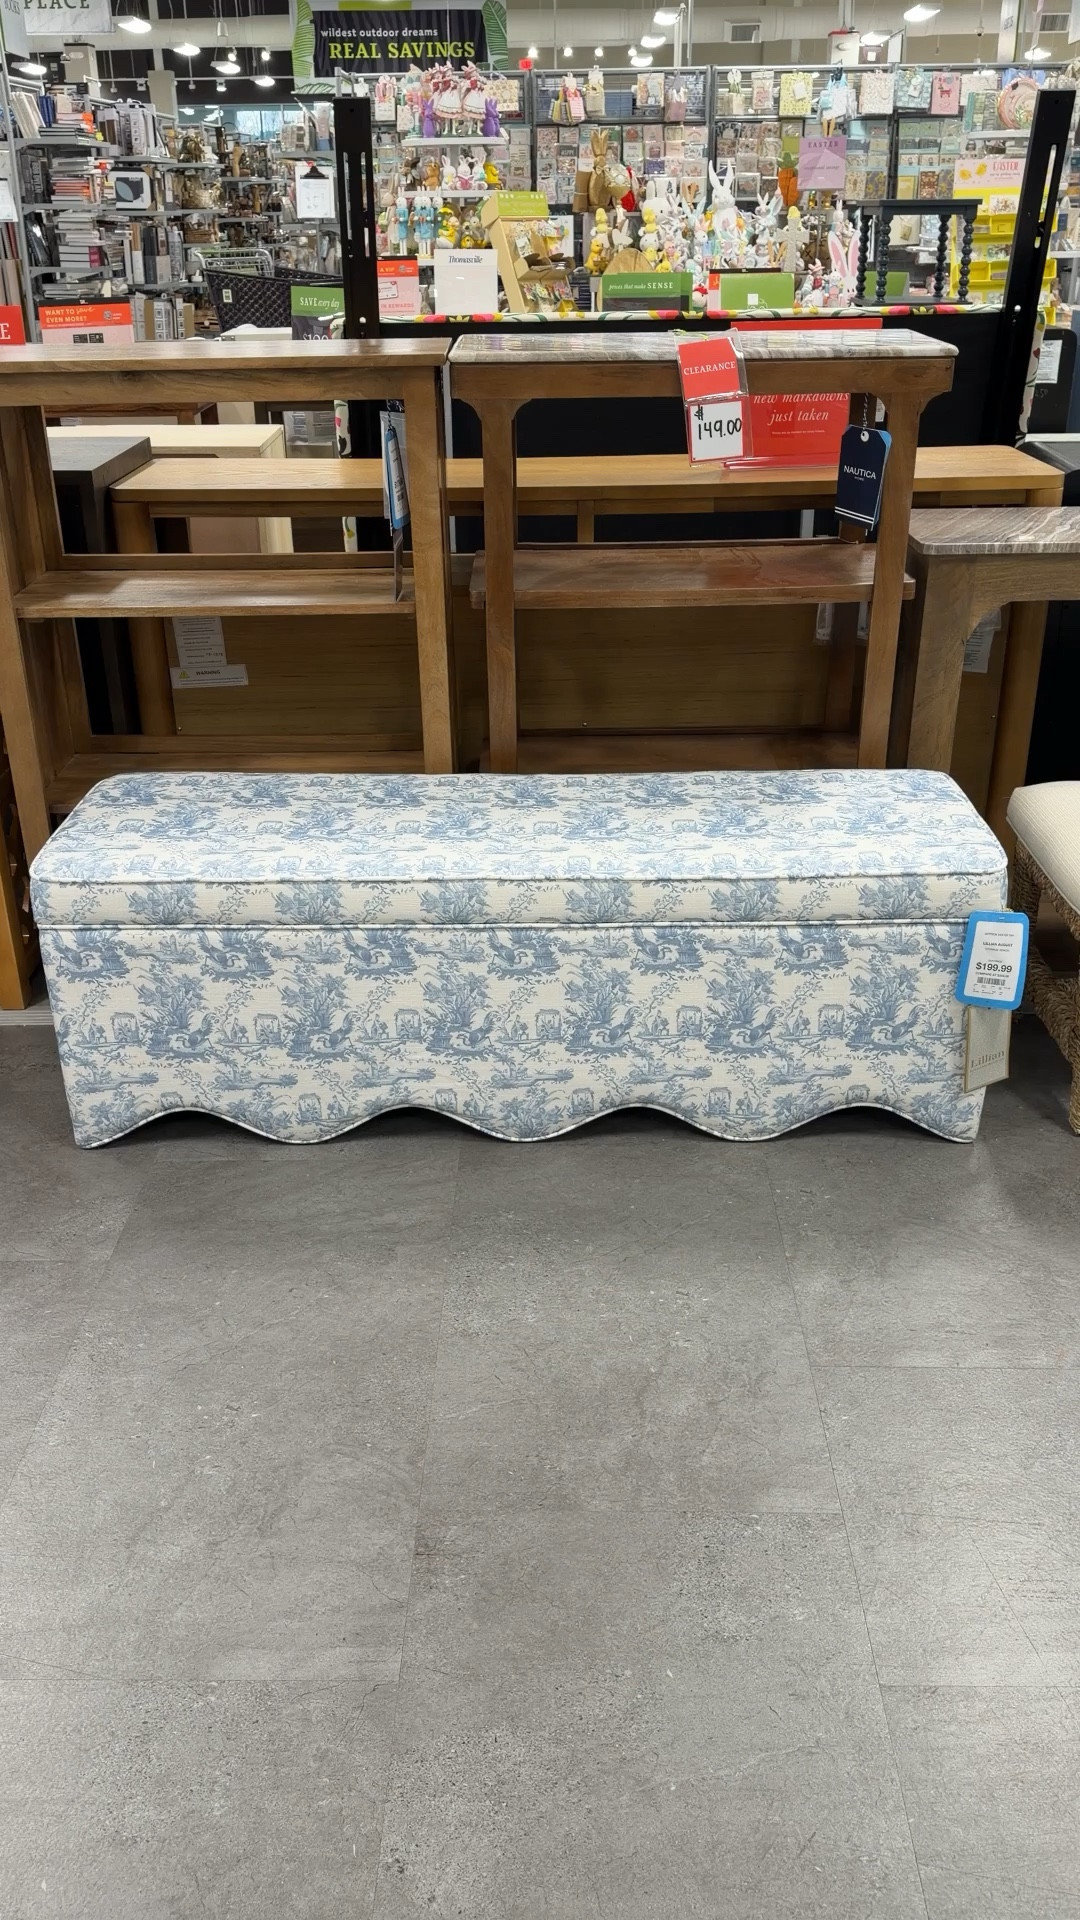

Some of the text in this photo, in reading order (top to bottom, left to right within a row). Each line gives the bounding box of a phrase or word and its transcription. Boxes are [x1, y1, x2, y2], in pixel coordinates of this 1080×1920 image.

[320, 27, 438, 37] wildest outdoor dreams
[329, 41, 475, 59] REAL SAVINGS
[993, 161, 1018, 171] EASTER
[448, 255, 483, 264] Thomasville
[300, 296, 340, 310] SAVE every day
[45, 306, 95, 316] WANT TO save
[65, 315, 87, 323] MORE?
[683, 360, 736, 376] CLEARANCE
[753, 395, 778, 404] new
[767, 408, 829, 426] just taken
[698, 417, 742, 440] 149.00
[843, 464, 877, 480] NAUTICA
[975, 961, 1013, 973] $199.99
[971, 1050, 1005, 1069] Lillian
